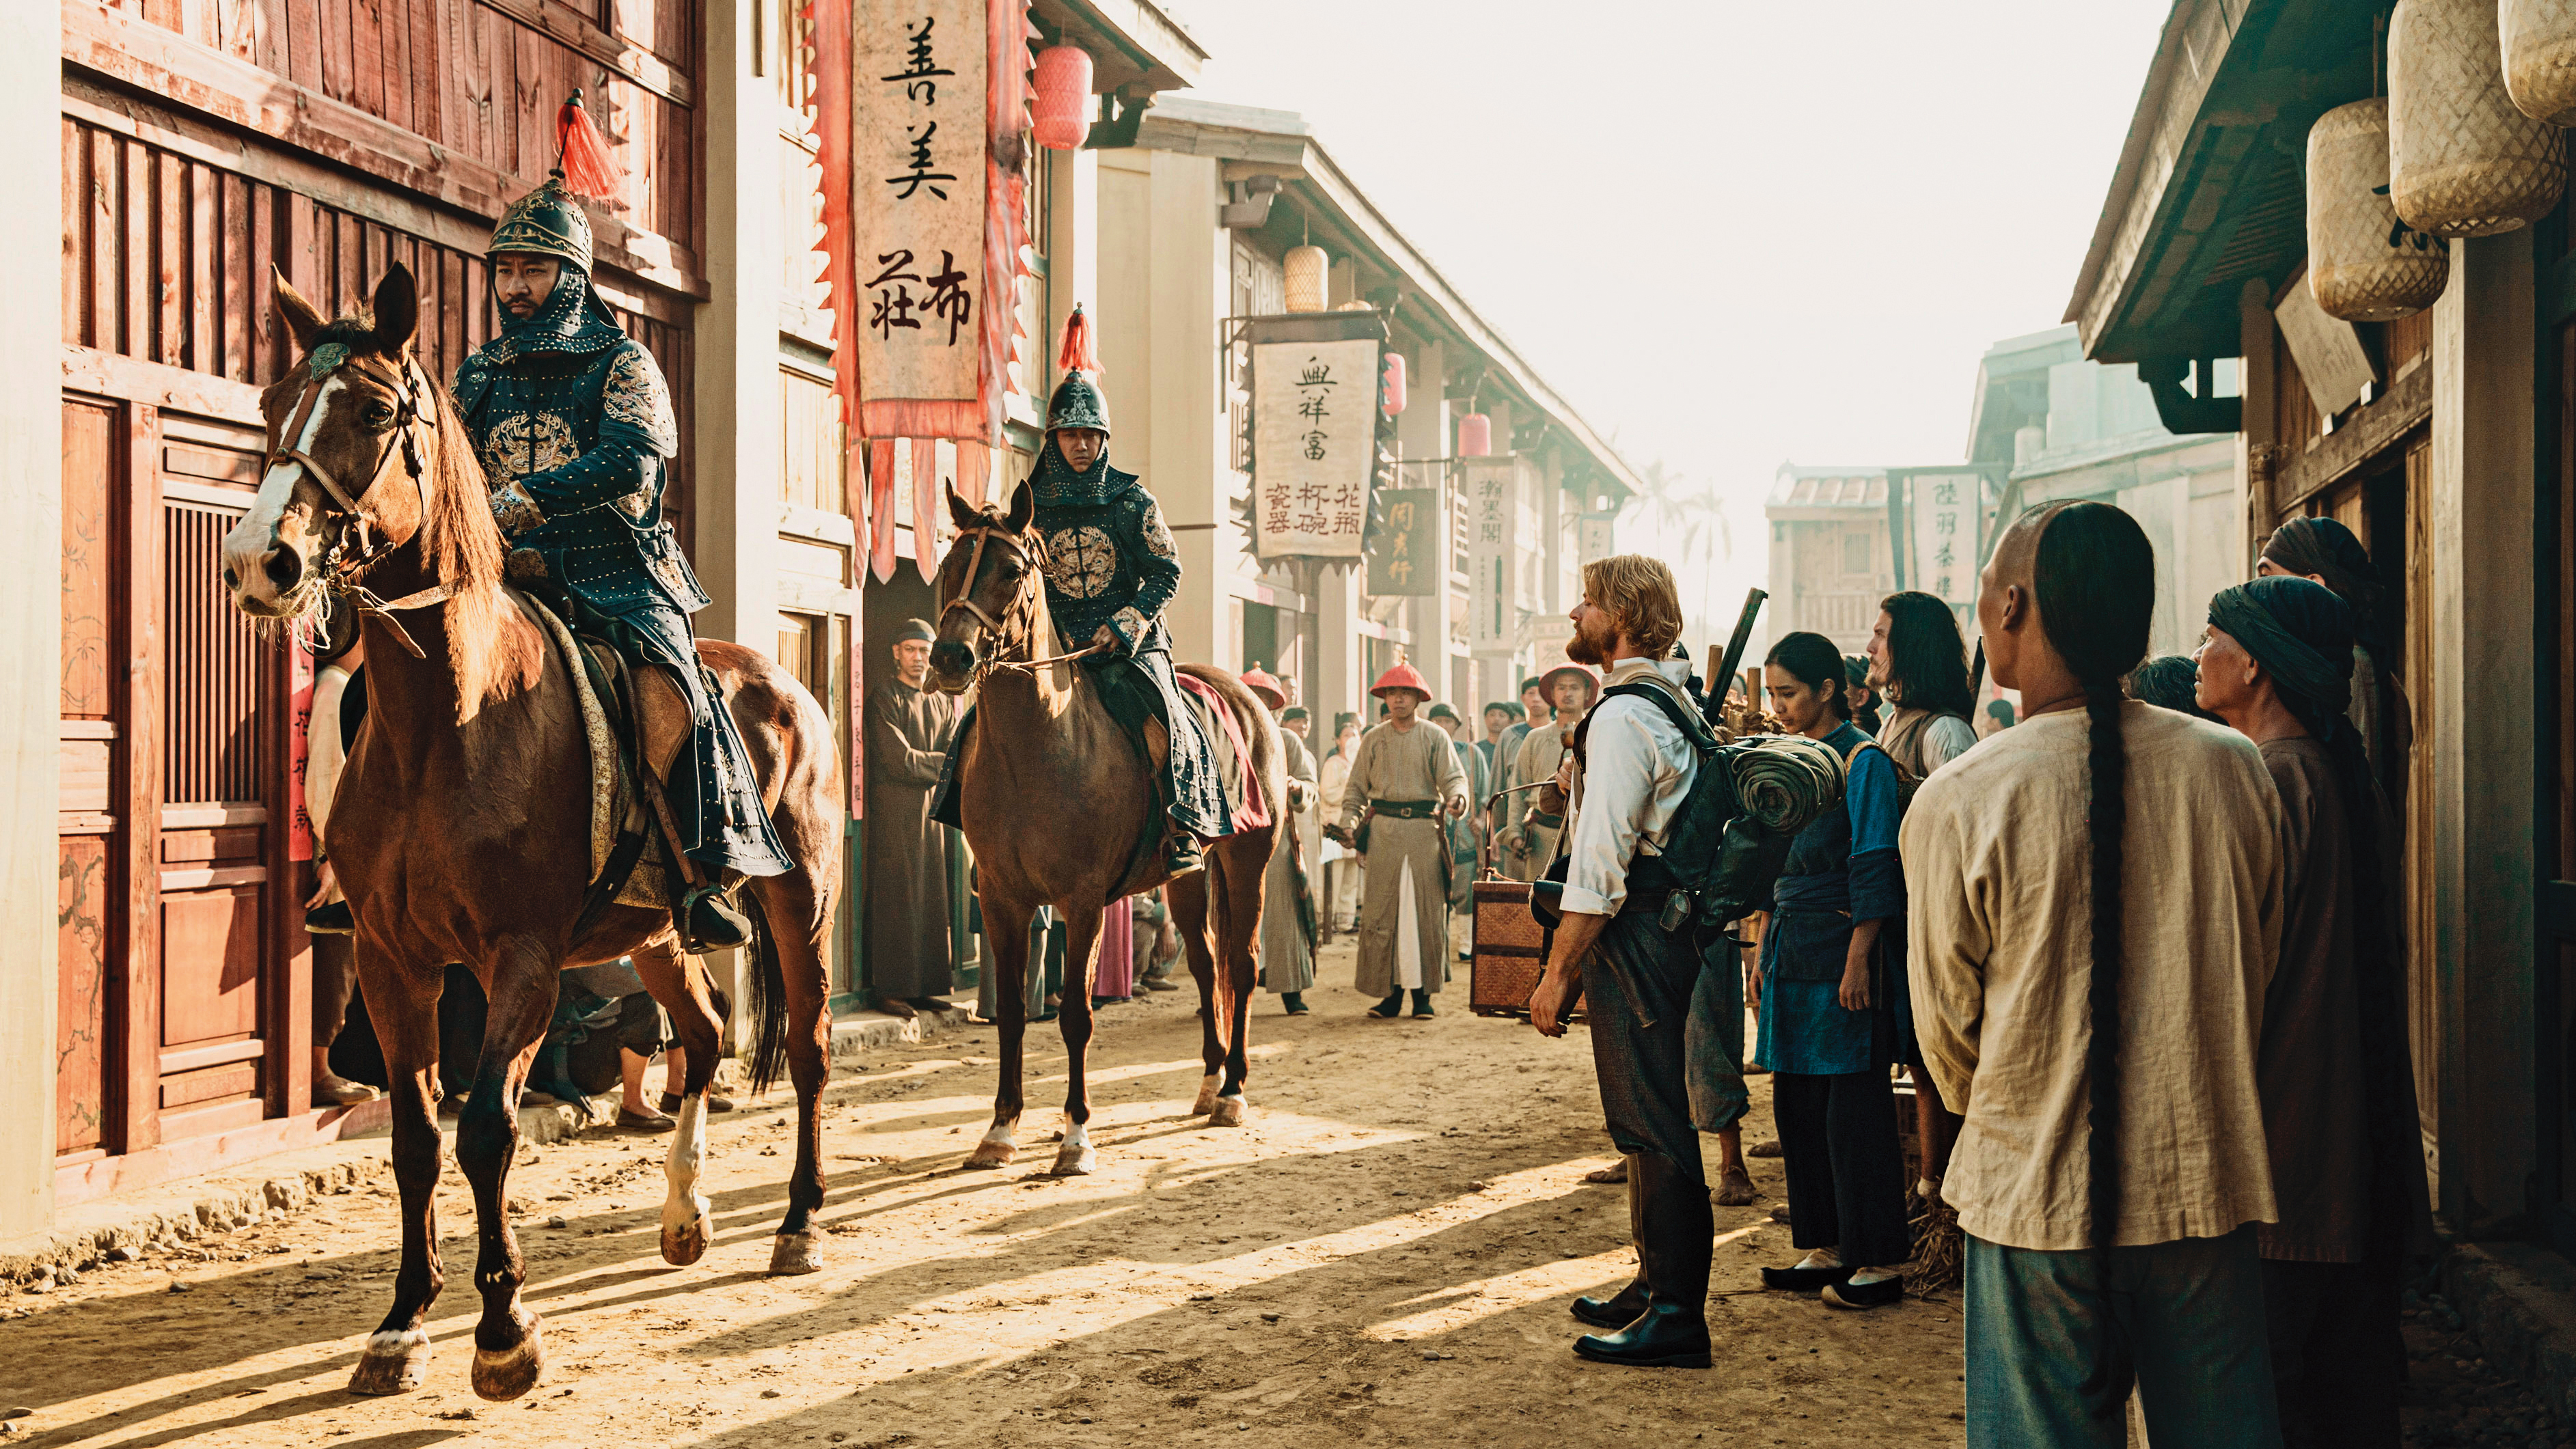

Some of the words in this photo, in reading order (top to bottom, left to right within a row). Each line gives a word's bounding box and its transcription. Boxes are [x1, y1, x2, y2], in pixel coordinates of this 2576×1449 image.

[881, 16, 957, 201] 善美
[1265, 483, 1291, 534] 瓷器
[1293, 482, 1330, 536] 杯碗
[1332, 483, 1360, 534] 花瓶
